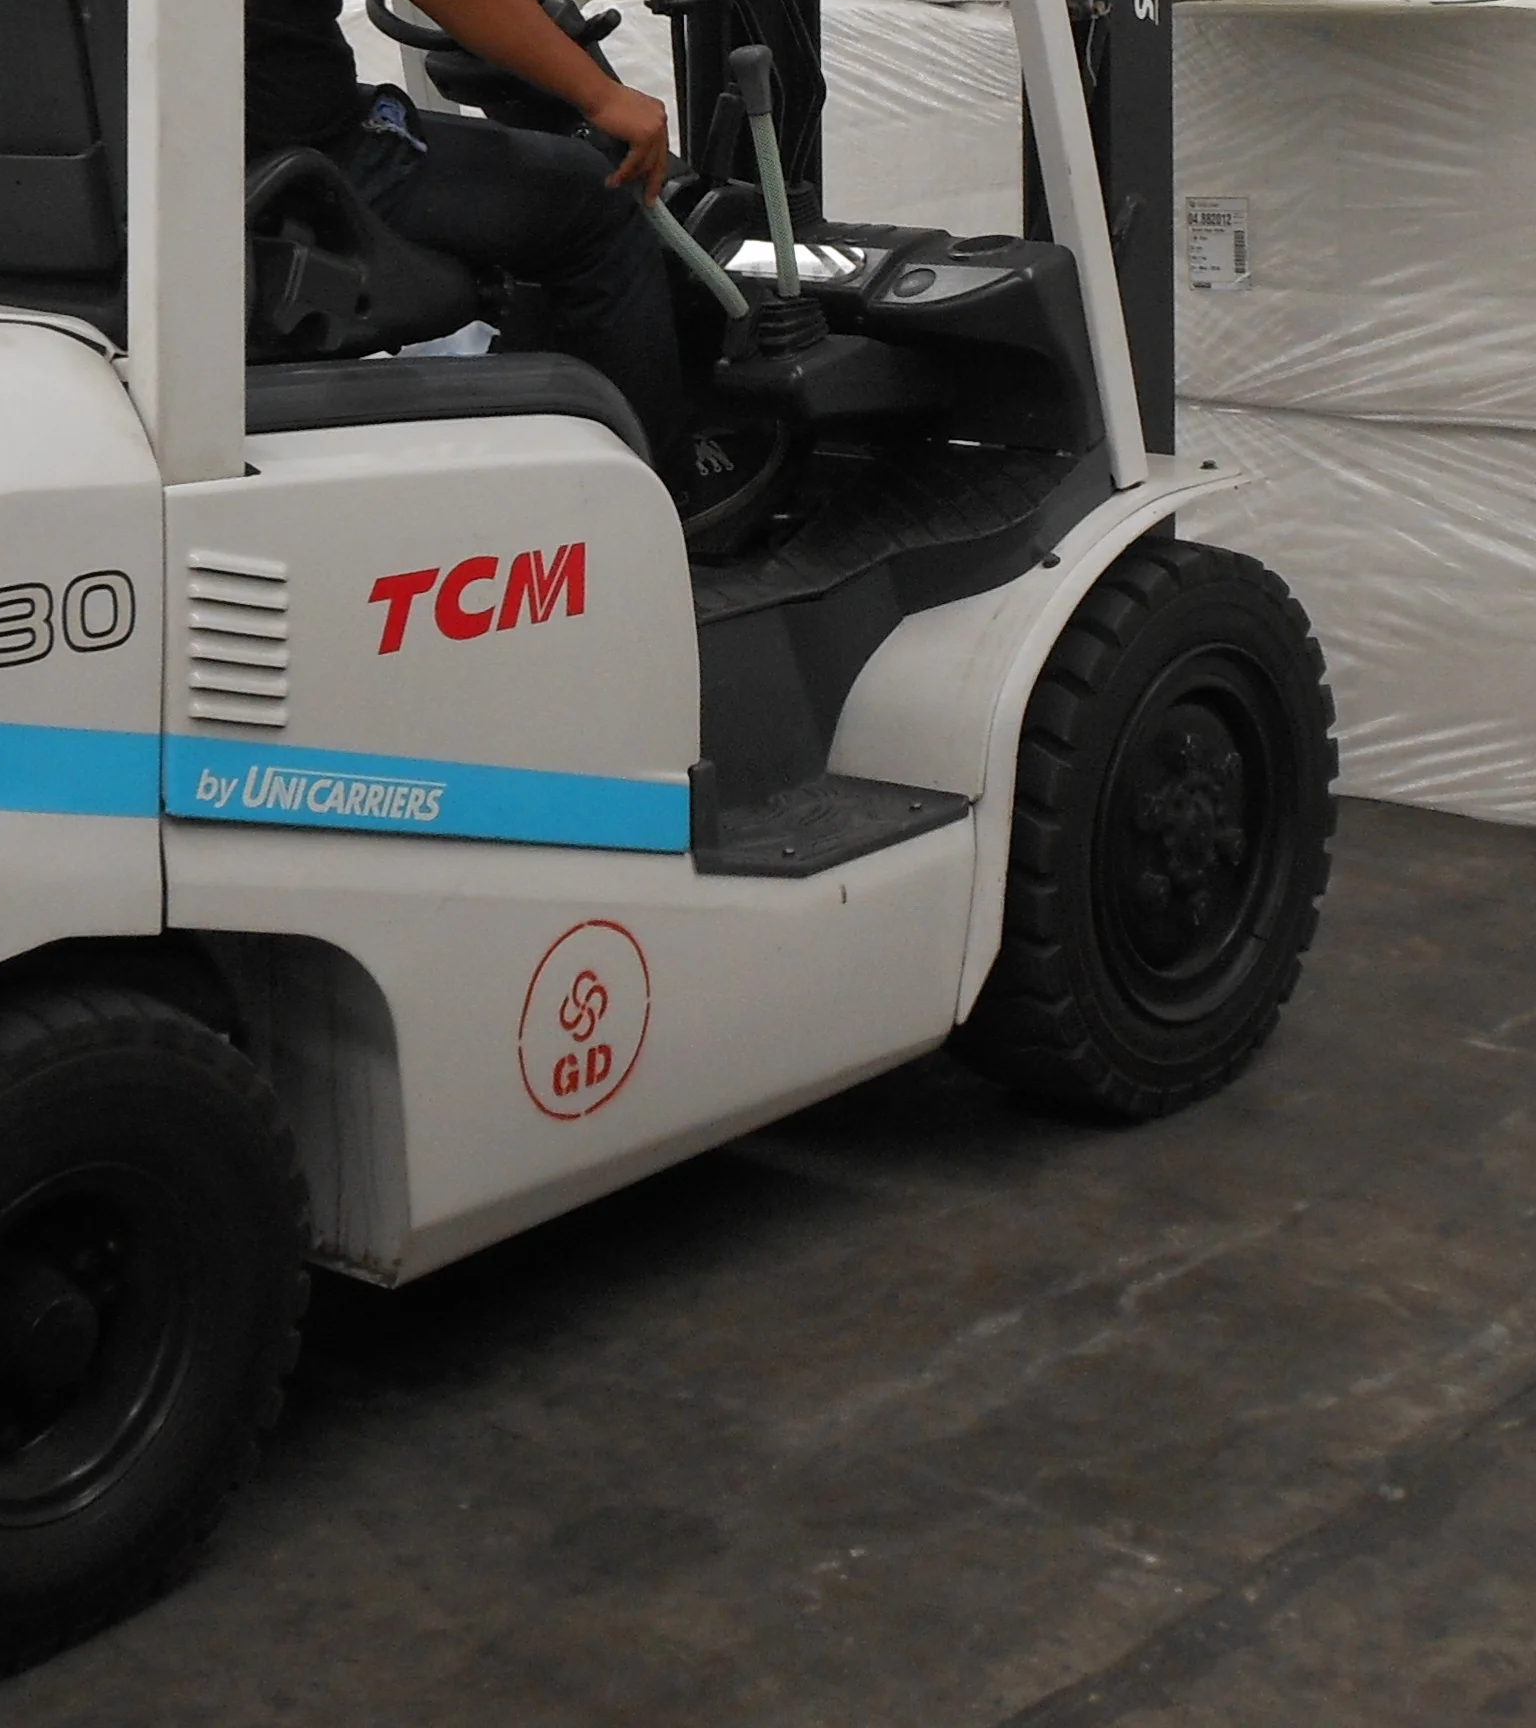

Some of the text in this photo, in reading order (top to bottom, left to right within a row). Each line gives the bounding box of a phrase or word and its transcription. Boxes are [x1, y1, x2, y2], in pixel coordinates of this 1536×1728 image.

[368, 542, 587, 655] TCM
[196, 769, 239, 809] by
[553, 1043, 613, 1097] GD
